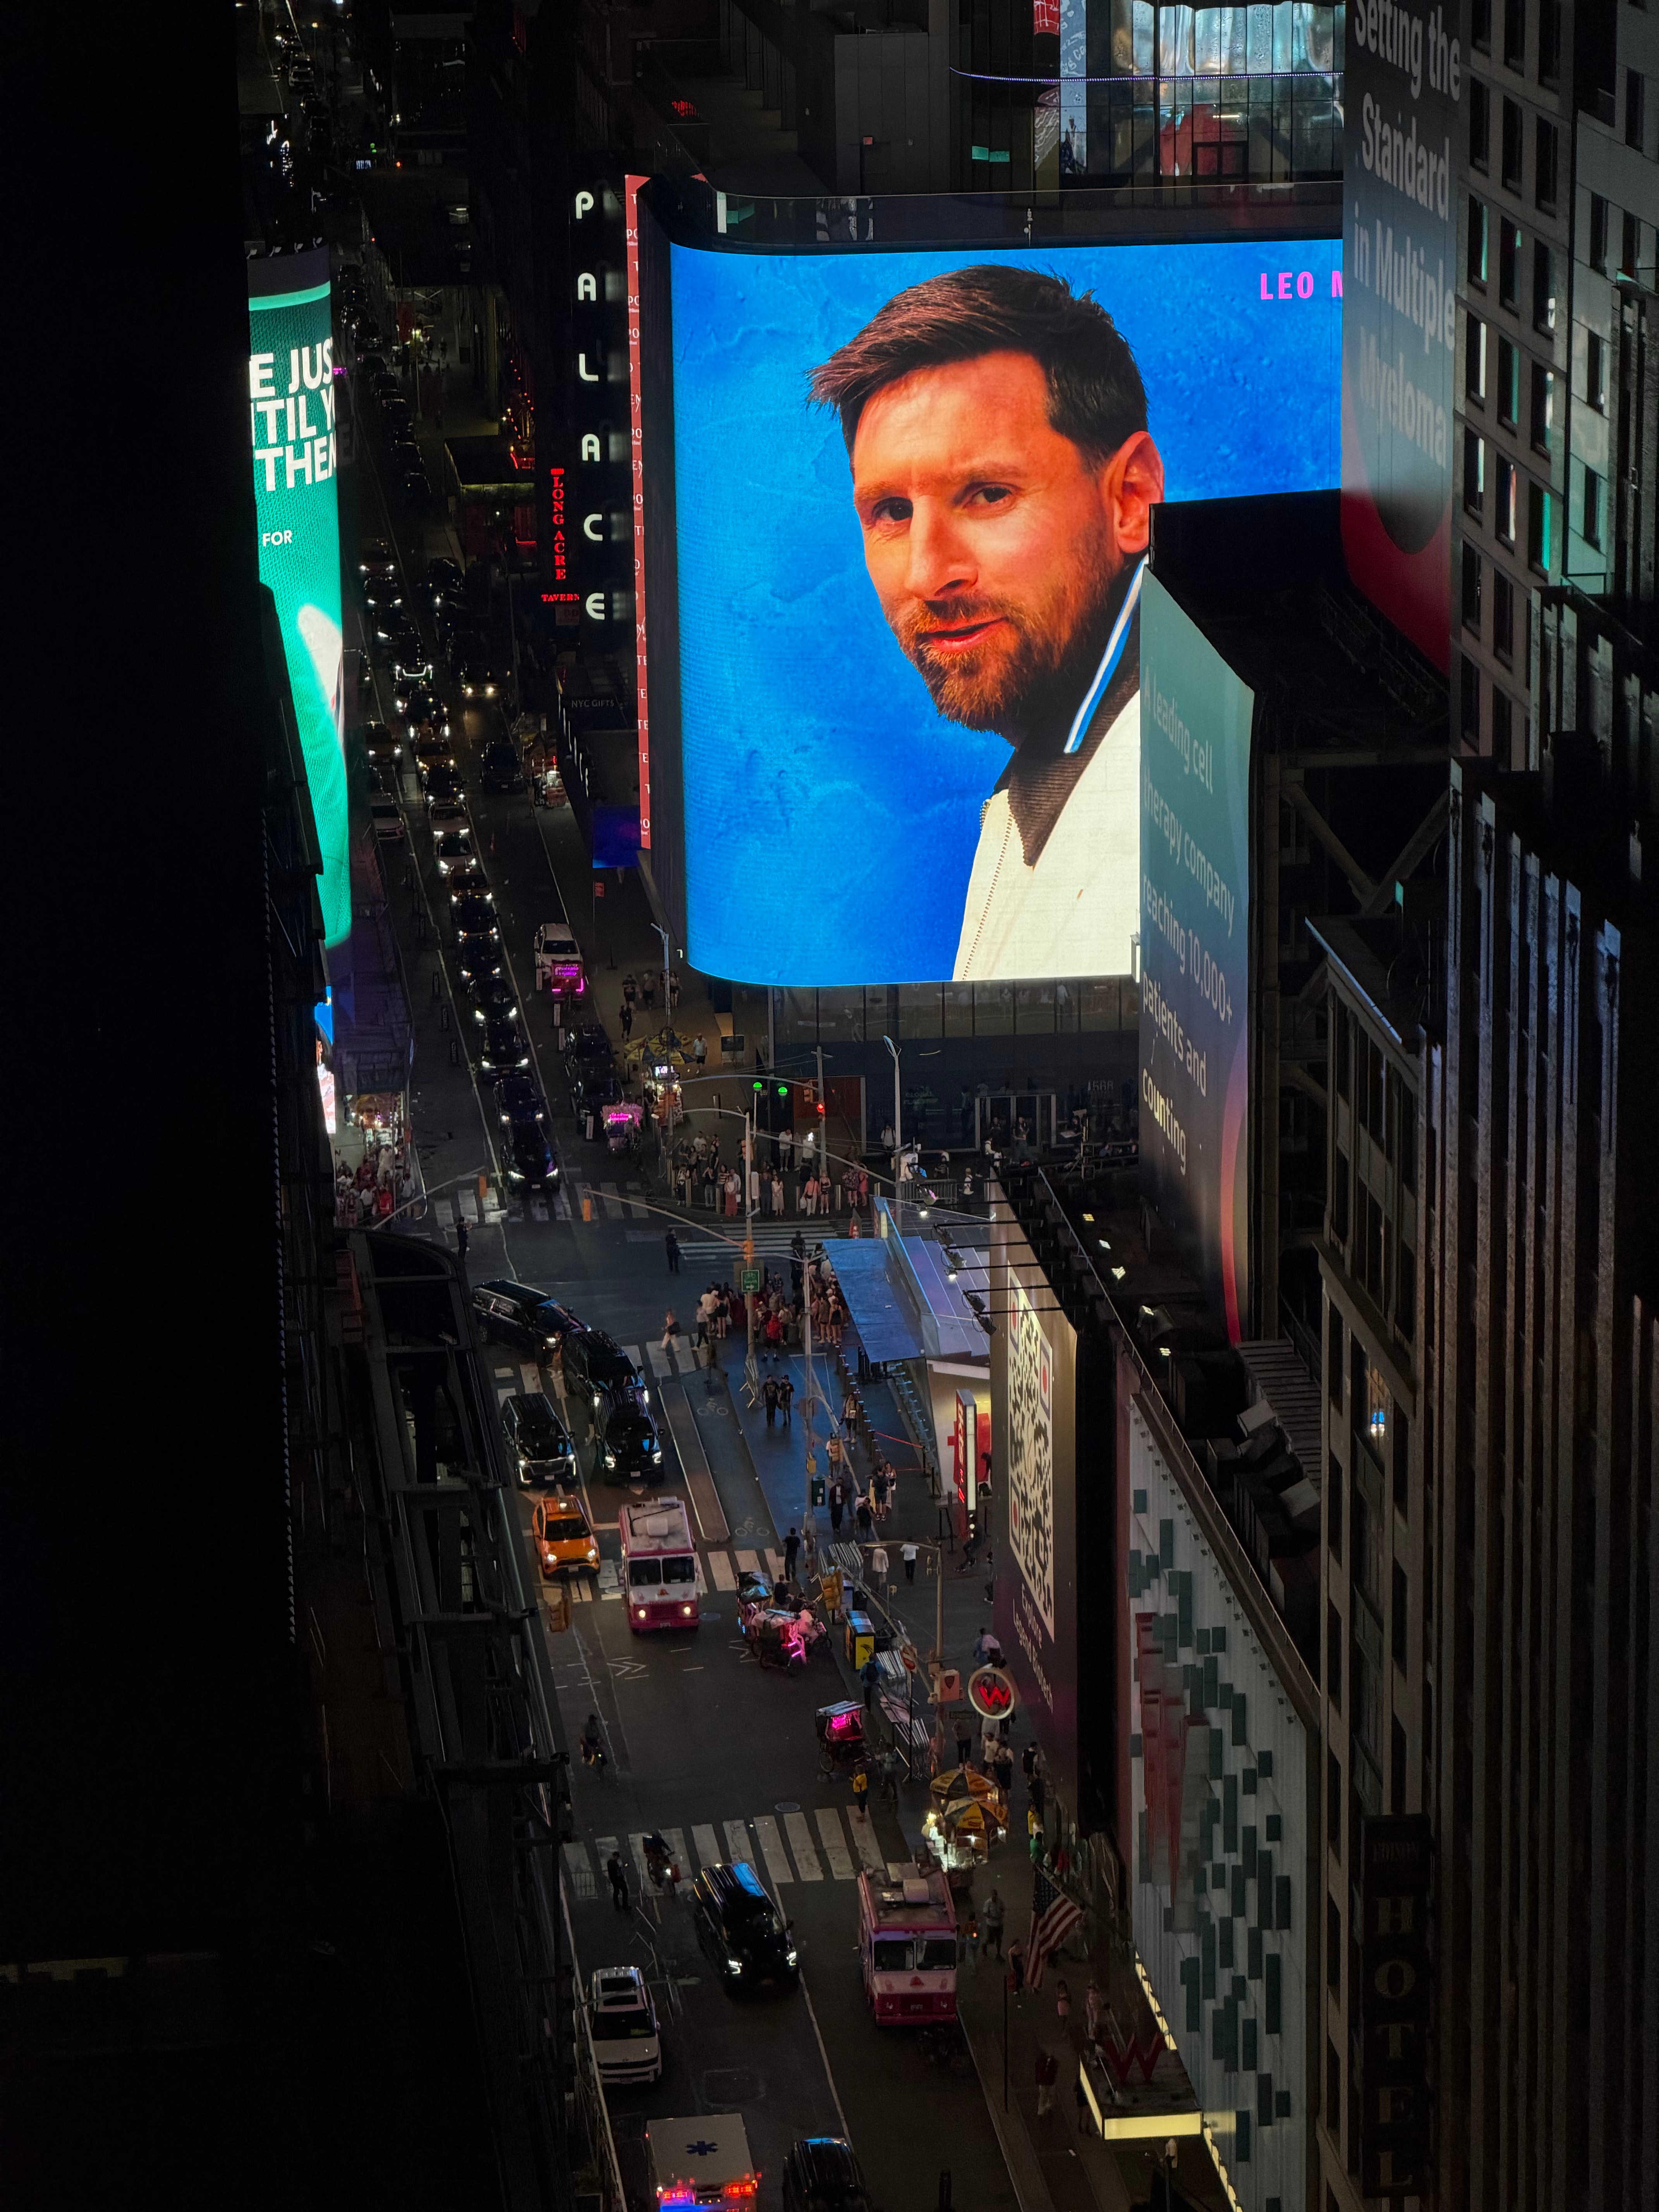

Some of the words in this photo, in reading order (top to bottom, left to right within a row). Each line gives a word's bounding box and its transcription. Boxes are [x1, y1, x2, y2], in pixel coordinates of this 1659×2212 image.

[1355, 0, 1423, 100] Setting
[1429, 5, 1460, 101] the
[1362, 92, 1449, 222] Standard
[1260, 271, 1314, 300] LEO
[1355, 201, 1370, 288] in
[1376, 218, 1455, 354] Multiple
[289, 336, 333, 394] JUS
[576, 191, 605, 620] PALACE
[1360, 326, 1446, 469] Myeloma
[251, 395, 317, 446] TIL
[262, 530, 293, 547] FOR
[552, 477, 564, 525] LONG
[541, 593, 580, 602] TAVERN
[553, 531, 566, 580] ACRE
[571, 699, 590, 708] NYC
[1153, 673, 1190, 775] leading
[1193, 740, 1213, 794] cell
[1144, 765, 1182, 865] therapy
[1184, 831, 1235, 938] company
[1143, 874, 1186, 975] reaching
[1188, 928, 1232, 1024] 10,000+
[1143, 970, 1183, 1061] patients
[1186, 1038, 1207, 1097] and
[1142, 1068, 1187, 1176] counting
[1013, 1598, 1032, 1663] Legend
[1032, 1644, 1054, 1714] Biotech
[1022, 1583, 1042, 1650] Explore
[977, 1685, 1011, 1709] W
[1104, 2033, 1164, 2083] W
